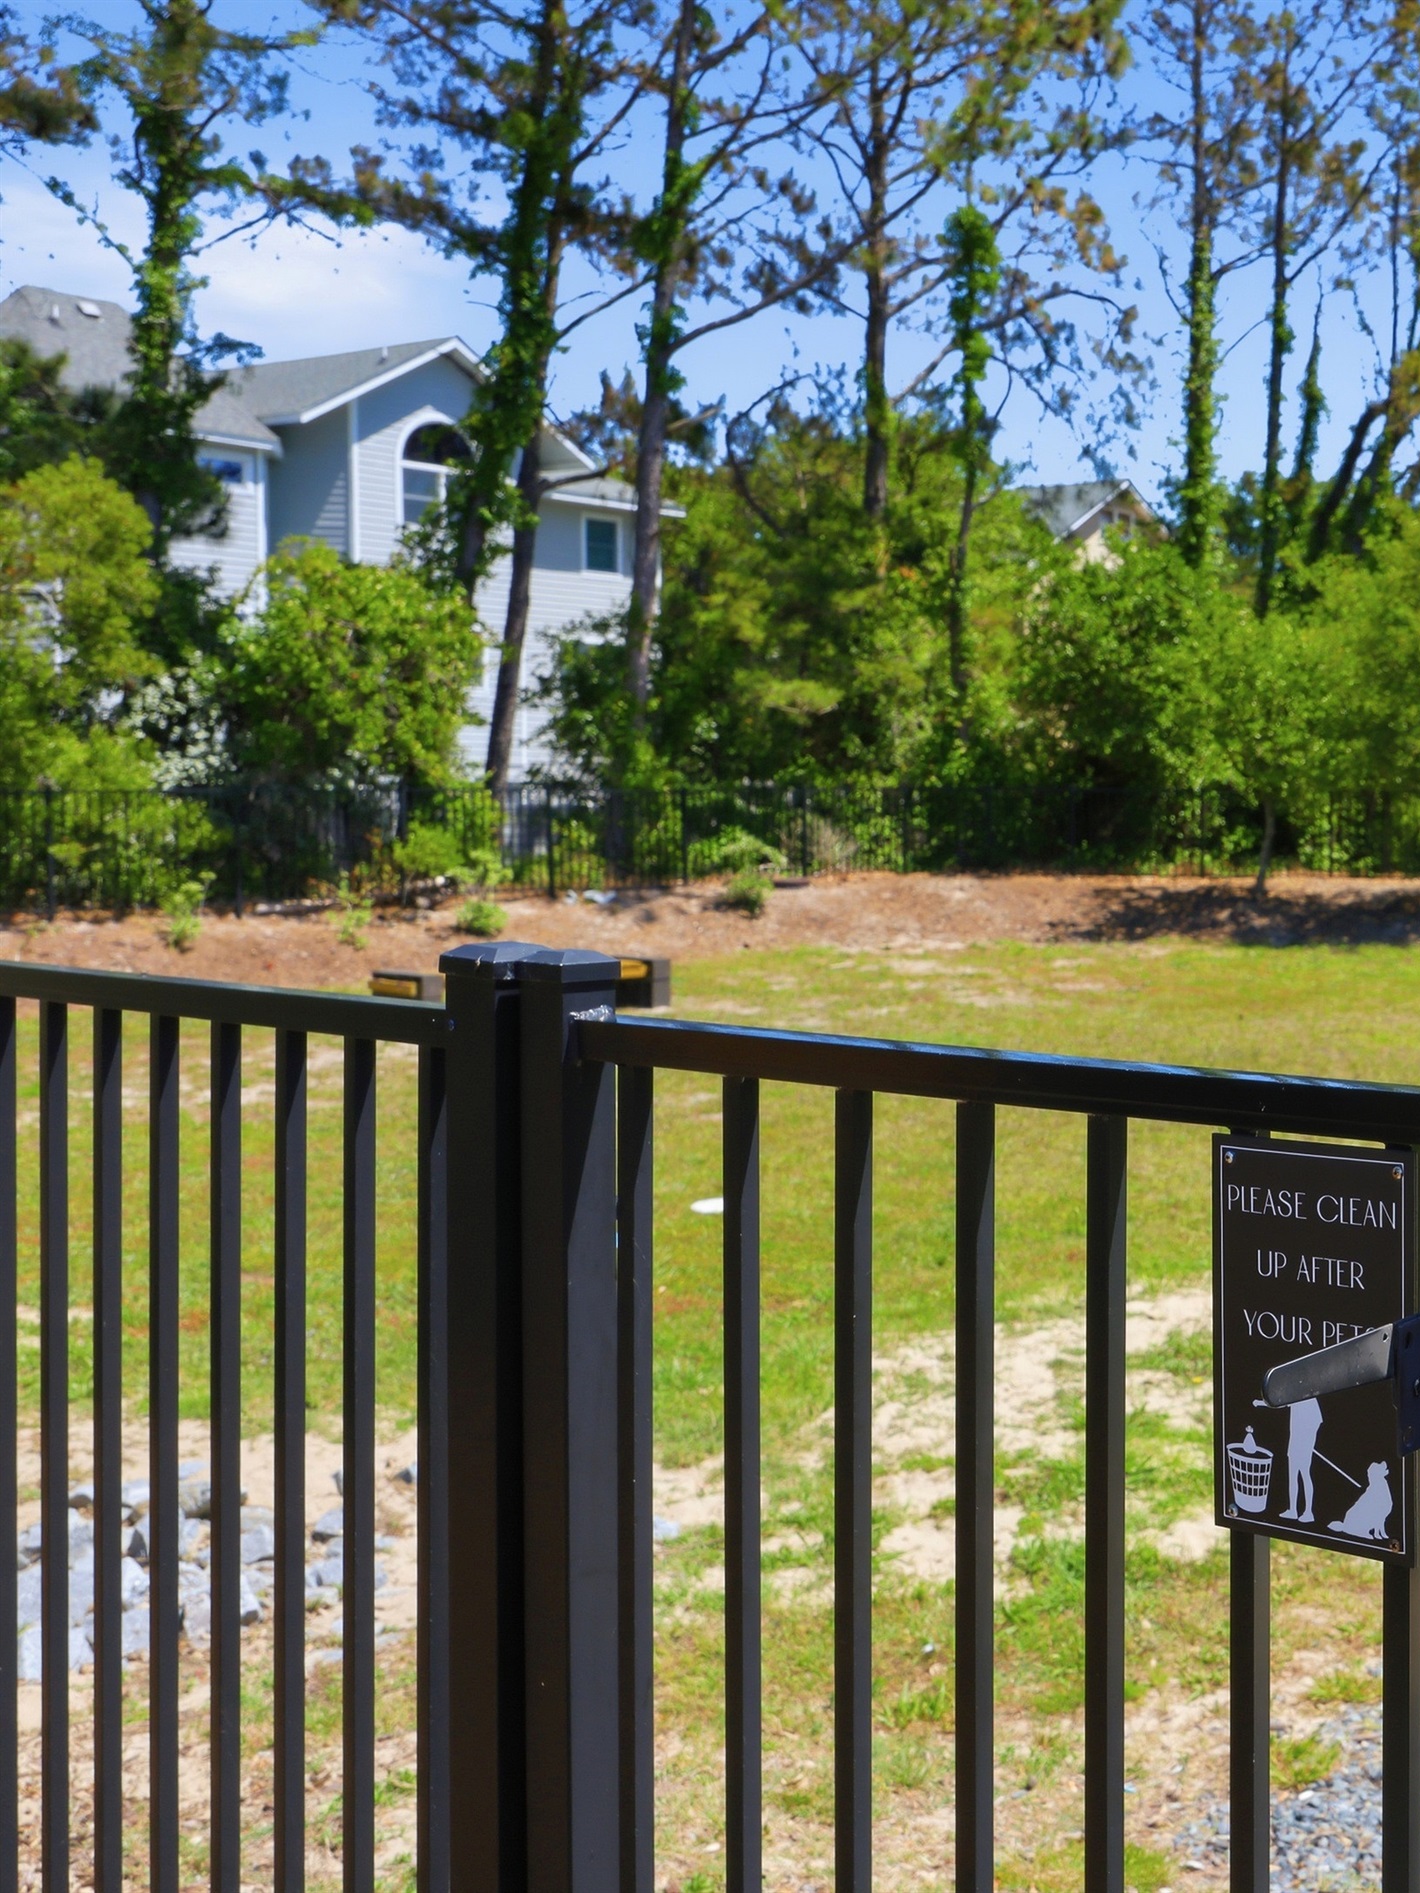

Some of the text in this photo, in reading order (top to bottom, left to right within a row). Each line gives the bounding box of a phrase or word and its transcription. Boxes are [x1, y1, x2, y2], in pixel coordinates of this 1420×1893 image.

[1228, 1185, 1395, 1229] PLEASE CLEAN
[1258, 1250, 1364, 1289] UP AFTER
[1244, 1309, 1375, 1348] YOUR PET
